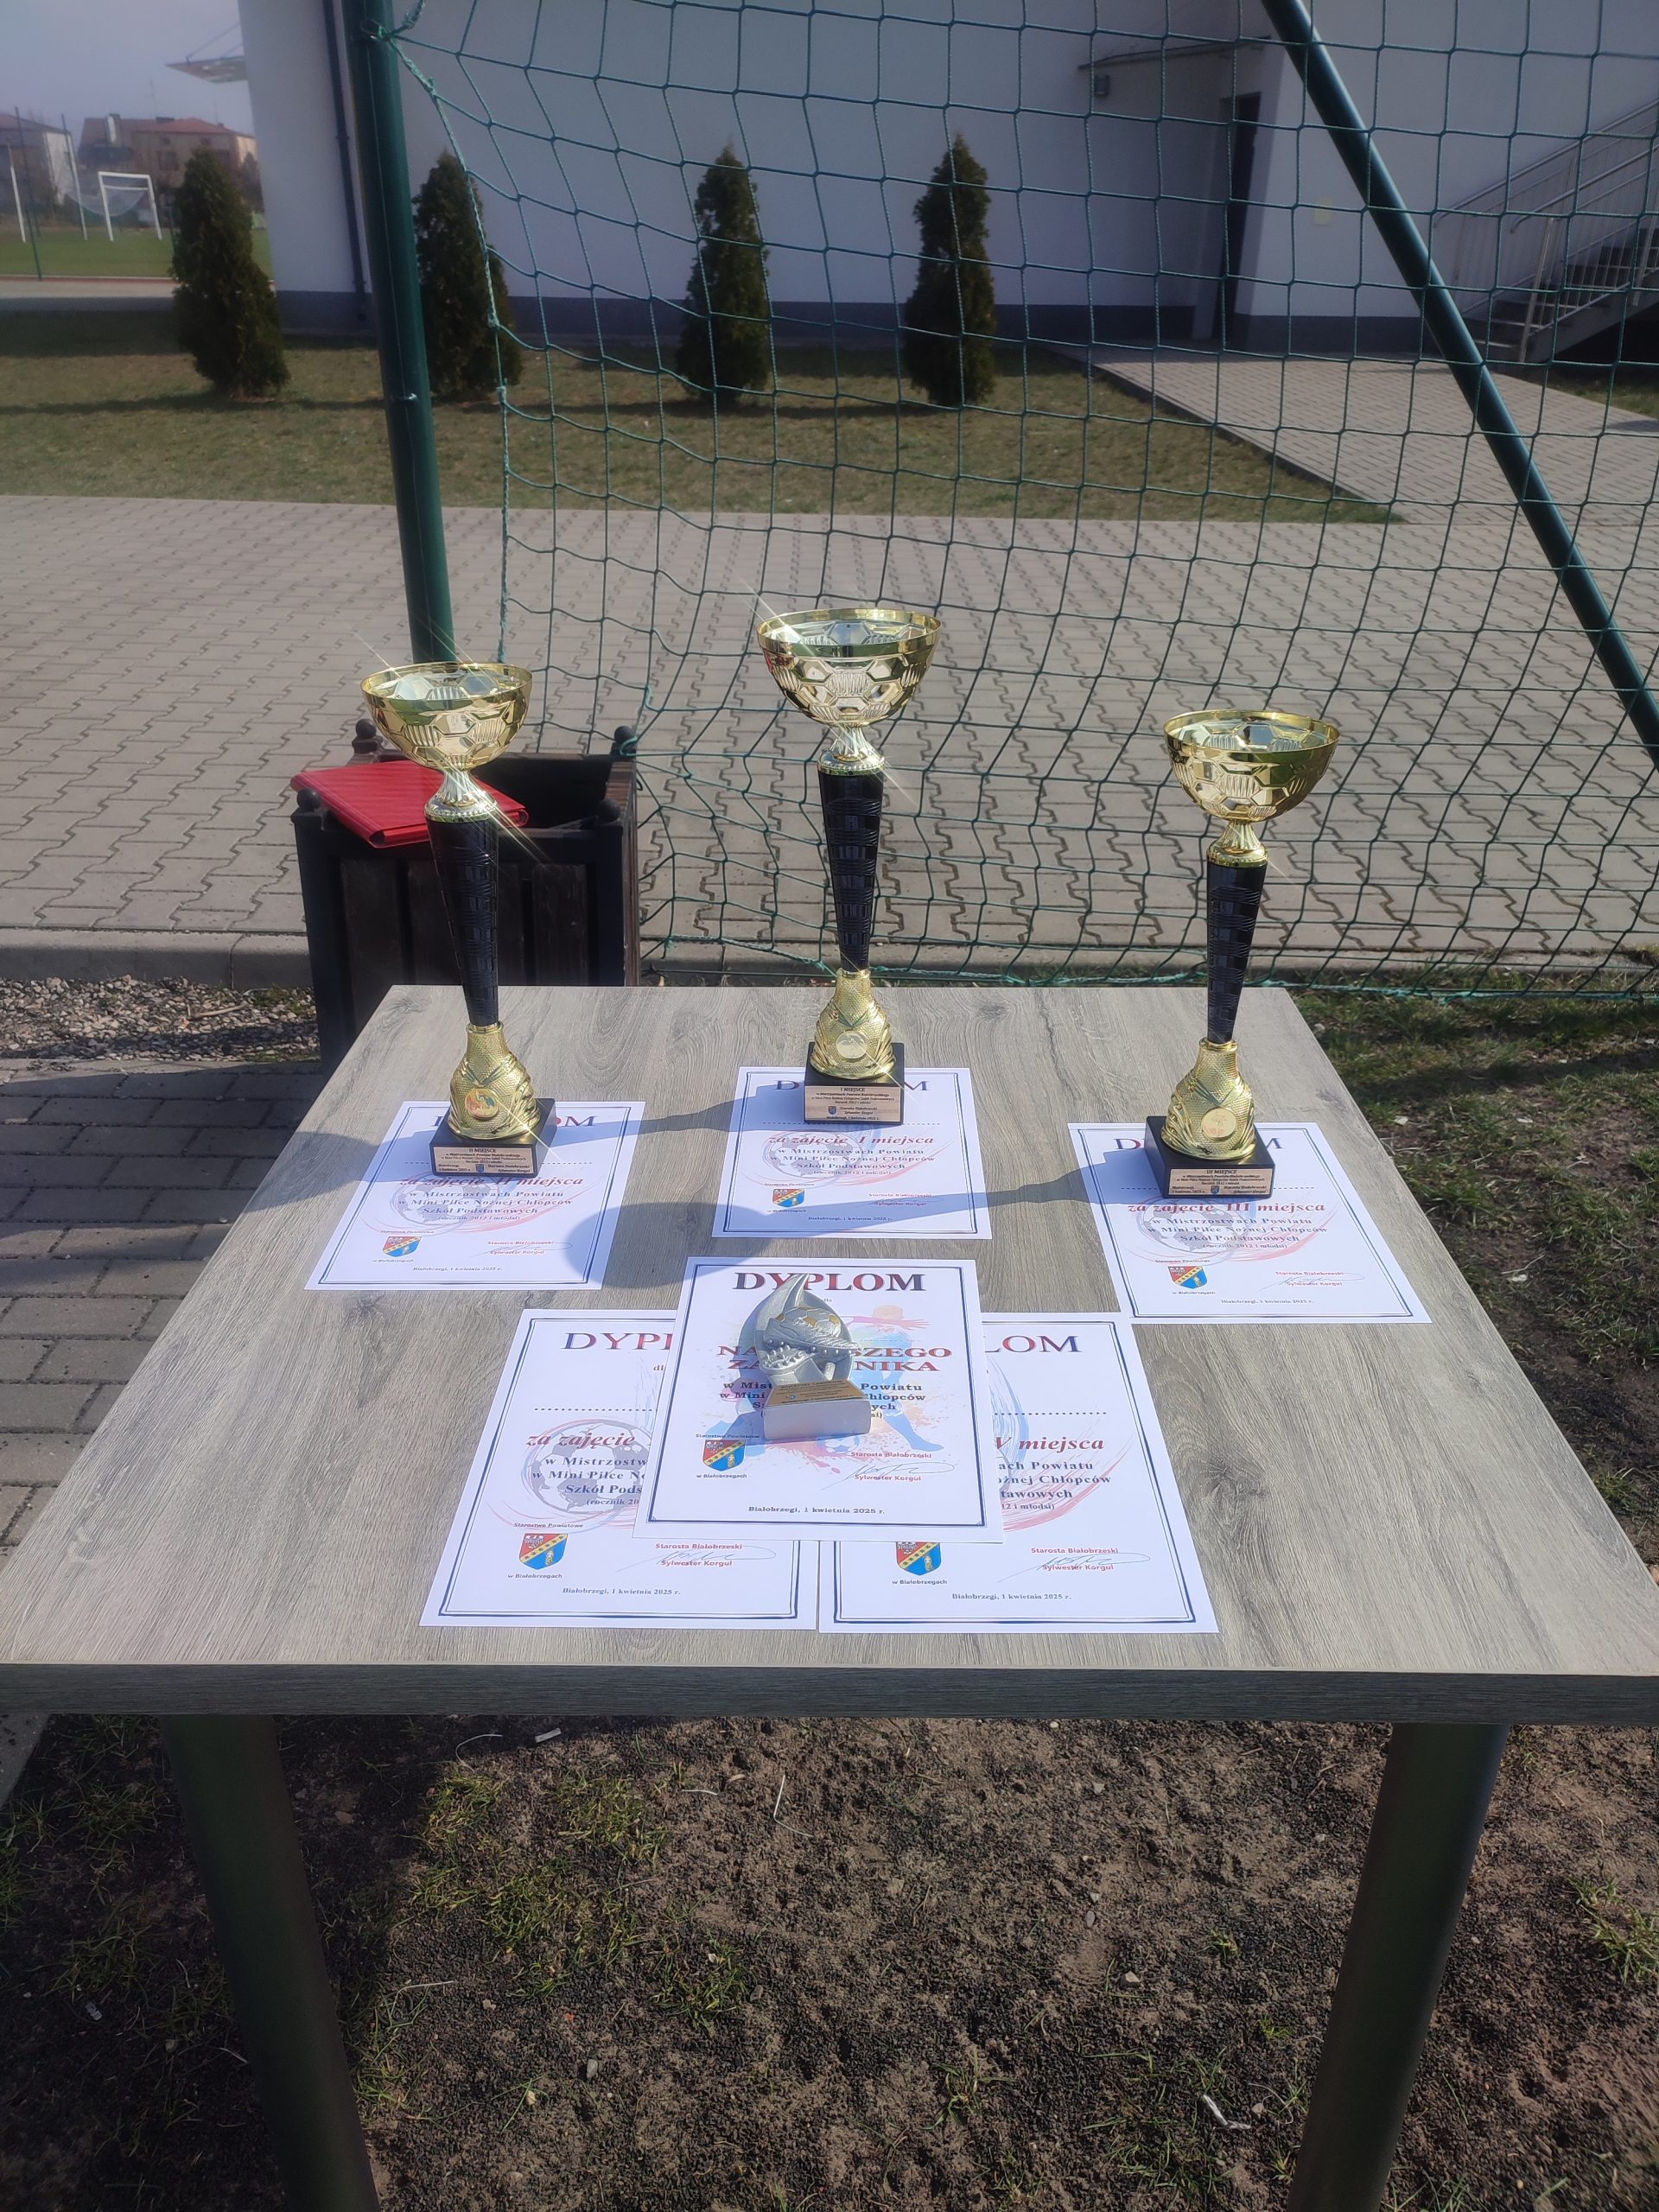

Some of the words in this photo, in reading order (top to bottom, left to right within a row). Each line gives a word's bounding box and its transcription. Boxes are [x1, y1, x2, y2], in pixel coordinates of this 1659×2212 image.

[791, 1136, 848, 1145] zajęcie
[872, 1136, 933, 1145] miejsca
[518, 1177, 583, 1186] miejsca
[1154, 1204, 1214, 1213] zajęcie
[1258, 1204, 1325, 1213] miejsca
[733, 1272, 926, 1291] DYPLOM
[526, 1436, 551, 1446] za
[558, 1433, 635, 1449] zajęcie
[1020, 1437, 1104, 1452] miejsca
[1039, 1476, 1111, 1485] Chłopców
[565, 1484, 604, 1493] Szkół
[1001, 1490, 1072, 1500] tawowych
